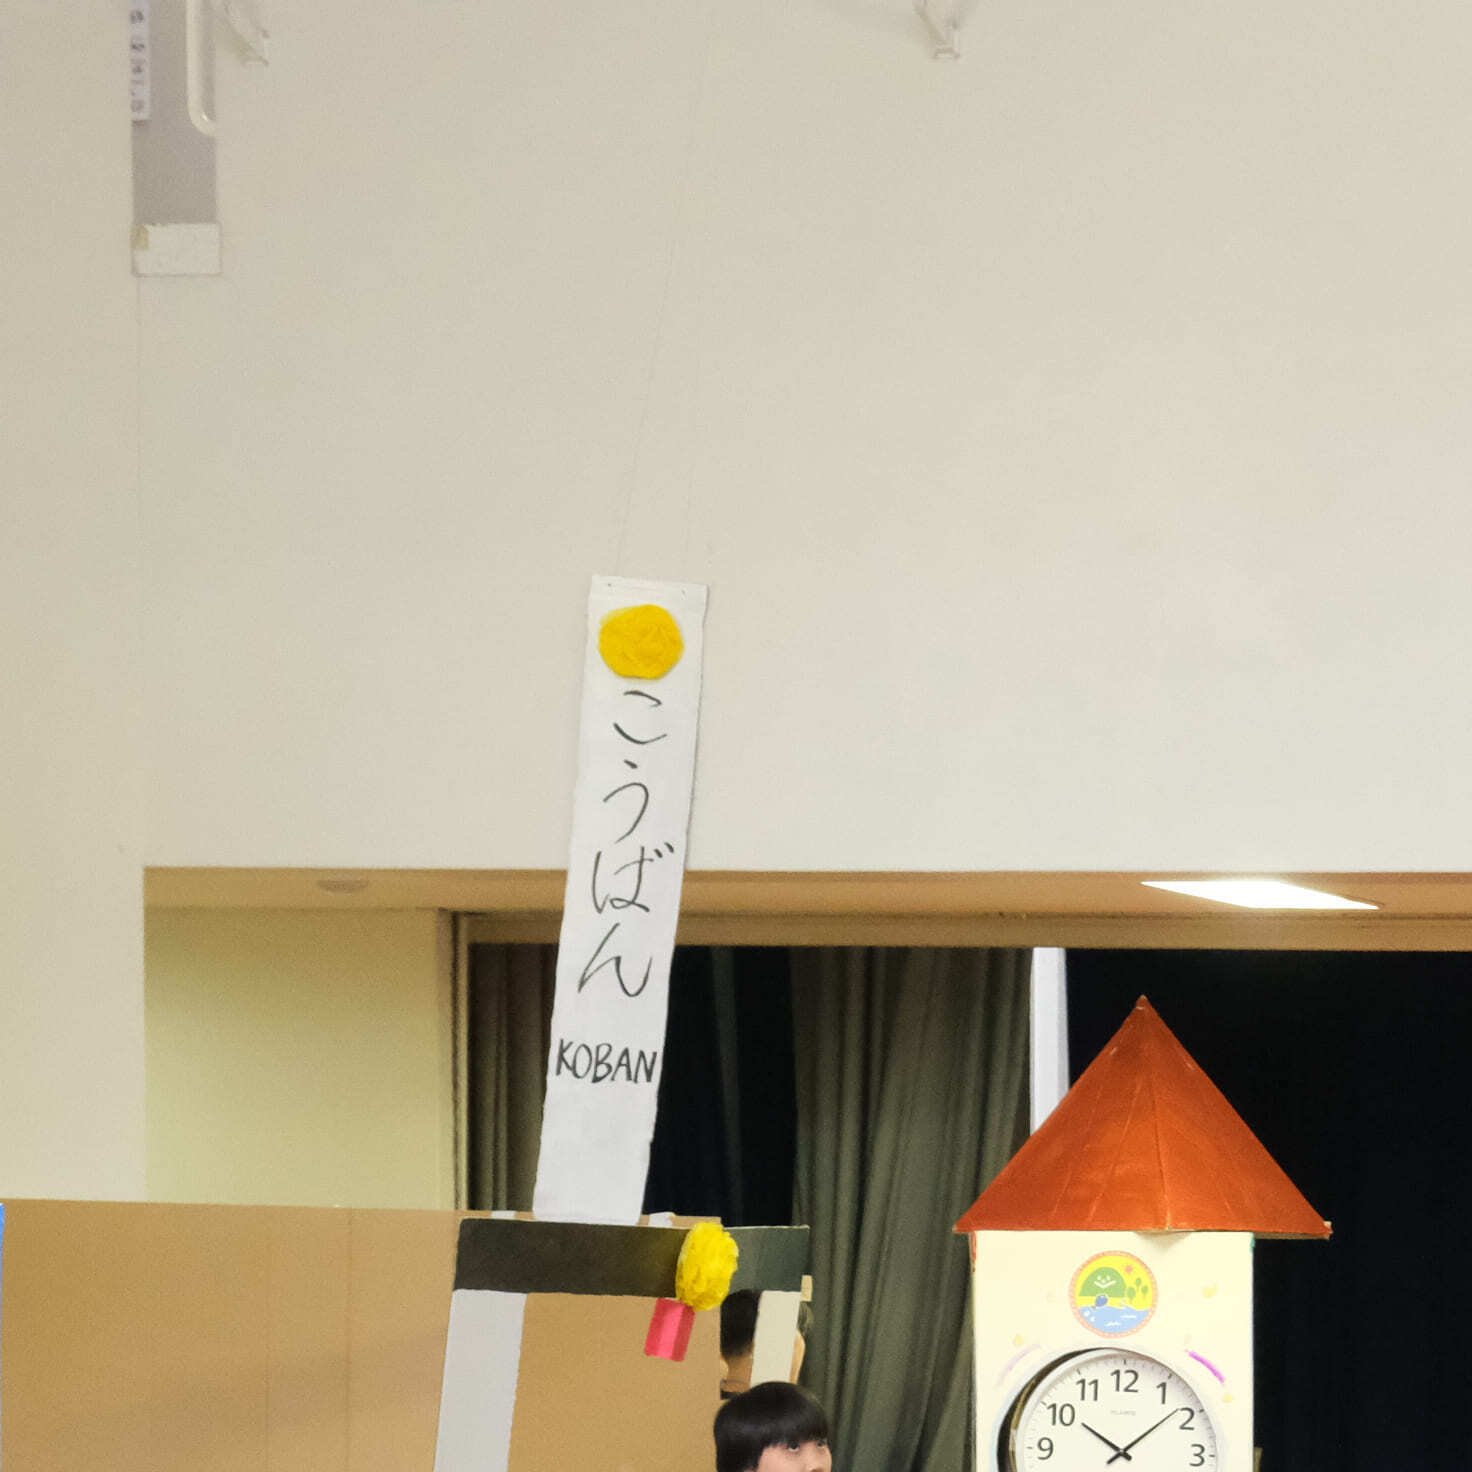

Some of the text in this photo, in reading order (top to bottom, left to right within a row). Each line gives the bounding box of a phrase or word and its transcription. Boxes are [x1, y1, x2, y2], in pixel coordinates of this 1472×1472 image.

[578, 689, 674, 998] こうばん
[555, 1037, 658, 1084] KOBAN
[1075, 1378, 1099, 1402] 11
[1110, 1368, 1140, 1393] 12
[1156, 1381, 1167, 1405] 1
[1047, 1402, 1076, 1427] 10
[1179, 1406, 1195, 1431] 2
[1036, 1436, 1054, 1461] 9
[1189, 1443, 1206, 1467] 3
